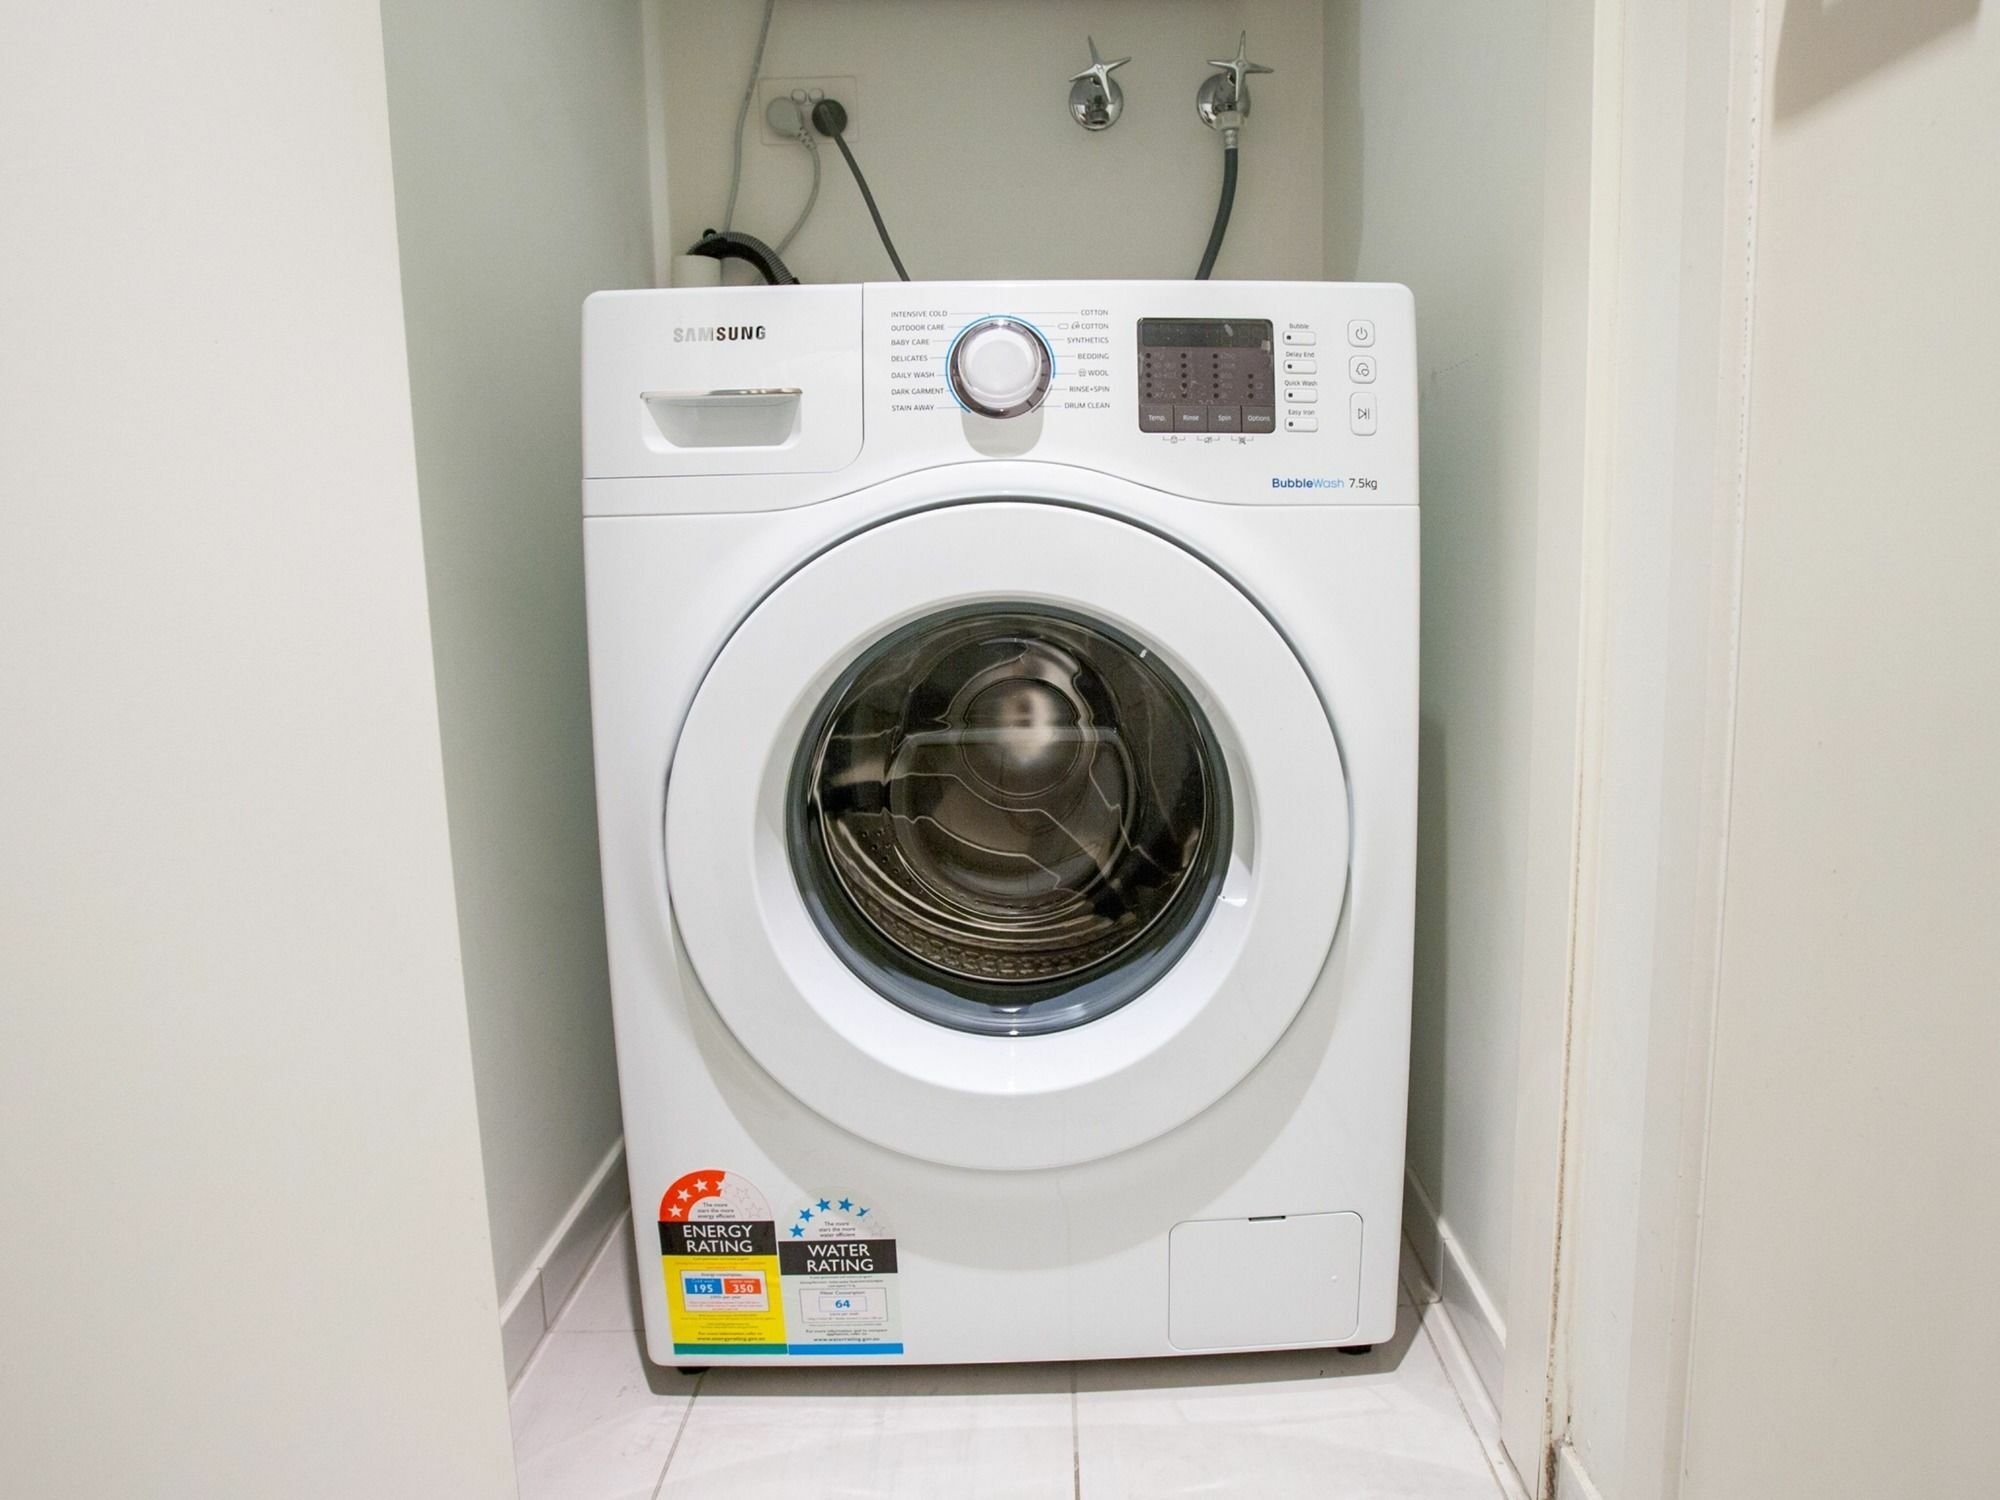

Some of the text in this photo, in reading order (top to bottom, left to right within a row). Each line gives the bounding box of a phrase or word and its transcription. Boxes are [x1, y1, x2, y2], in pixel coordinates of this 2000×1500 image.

[673, 325, 766, 343] SAMSUNG
[1285, 351, 1304, 359] Delay
[891, 371, 912, 379] DAILY
[891, 388, 912, 396] DARK
[1218, 414, 1232, 422] Spin
[1247, 414, 1271, 422] Options
[1272, 478, 1378, 490] BubbleWash 7.5kg
[683, 1224, 753, 1238] ENERGY
[686, 1240, 753, 1253] RATING
[807, 1243, 870, 1257] WATER
[806, 1258, 874, 1273] RATING
[694, 1284, 714, 1293] 195
[732, 1284, 754, 1293] 350
[834, 1299, 850, 1308] 64
